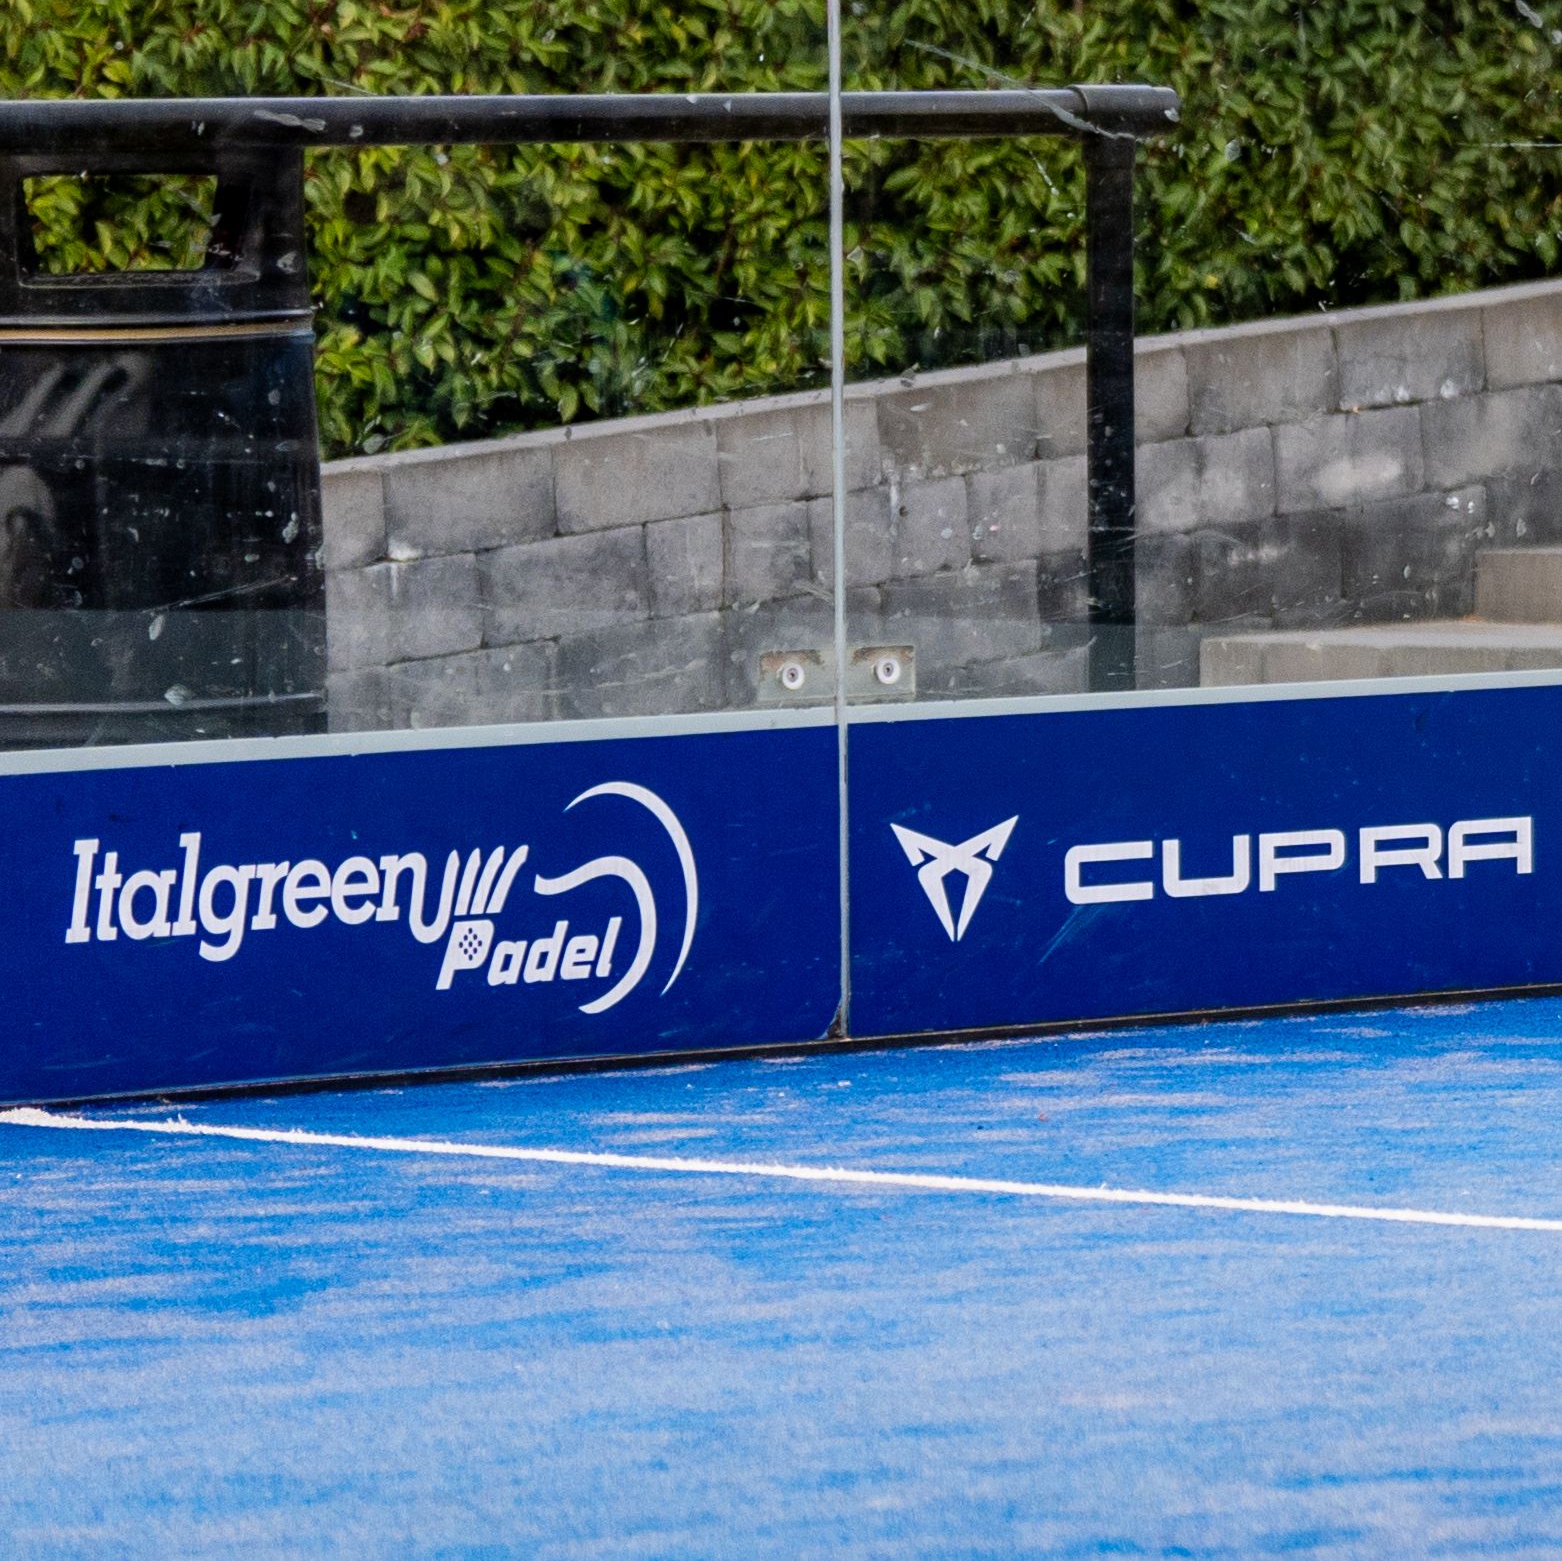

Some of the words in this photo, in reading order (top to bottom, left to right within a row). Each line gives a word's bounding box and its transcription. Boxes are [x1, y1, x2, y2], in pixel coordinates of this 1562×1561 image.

[65, 831, 446, 962] Italgreen
[1064, 816, 1533, 905] CUPRA
[435, 916, 623, 991] Padel
